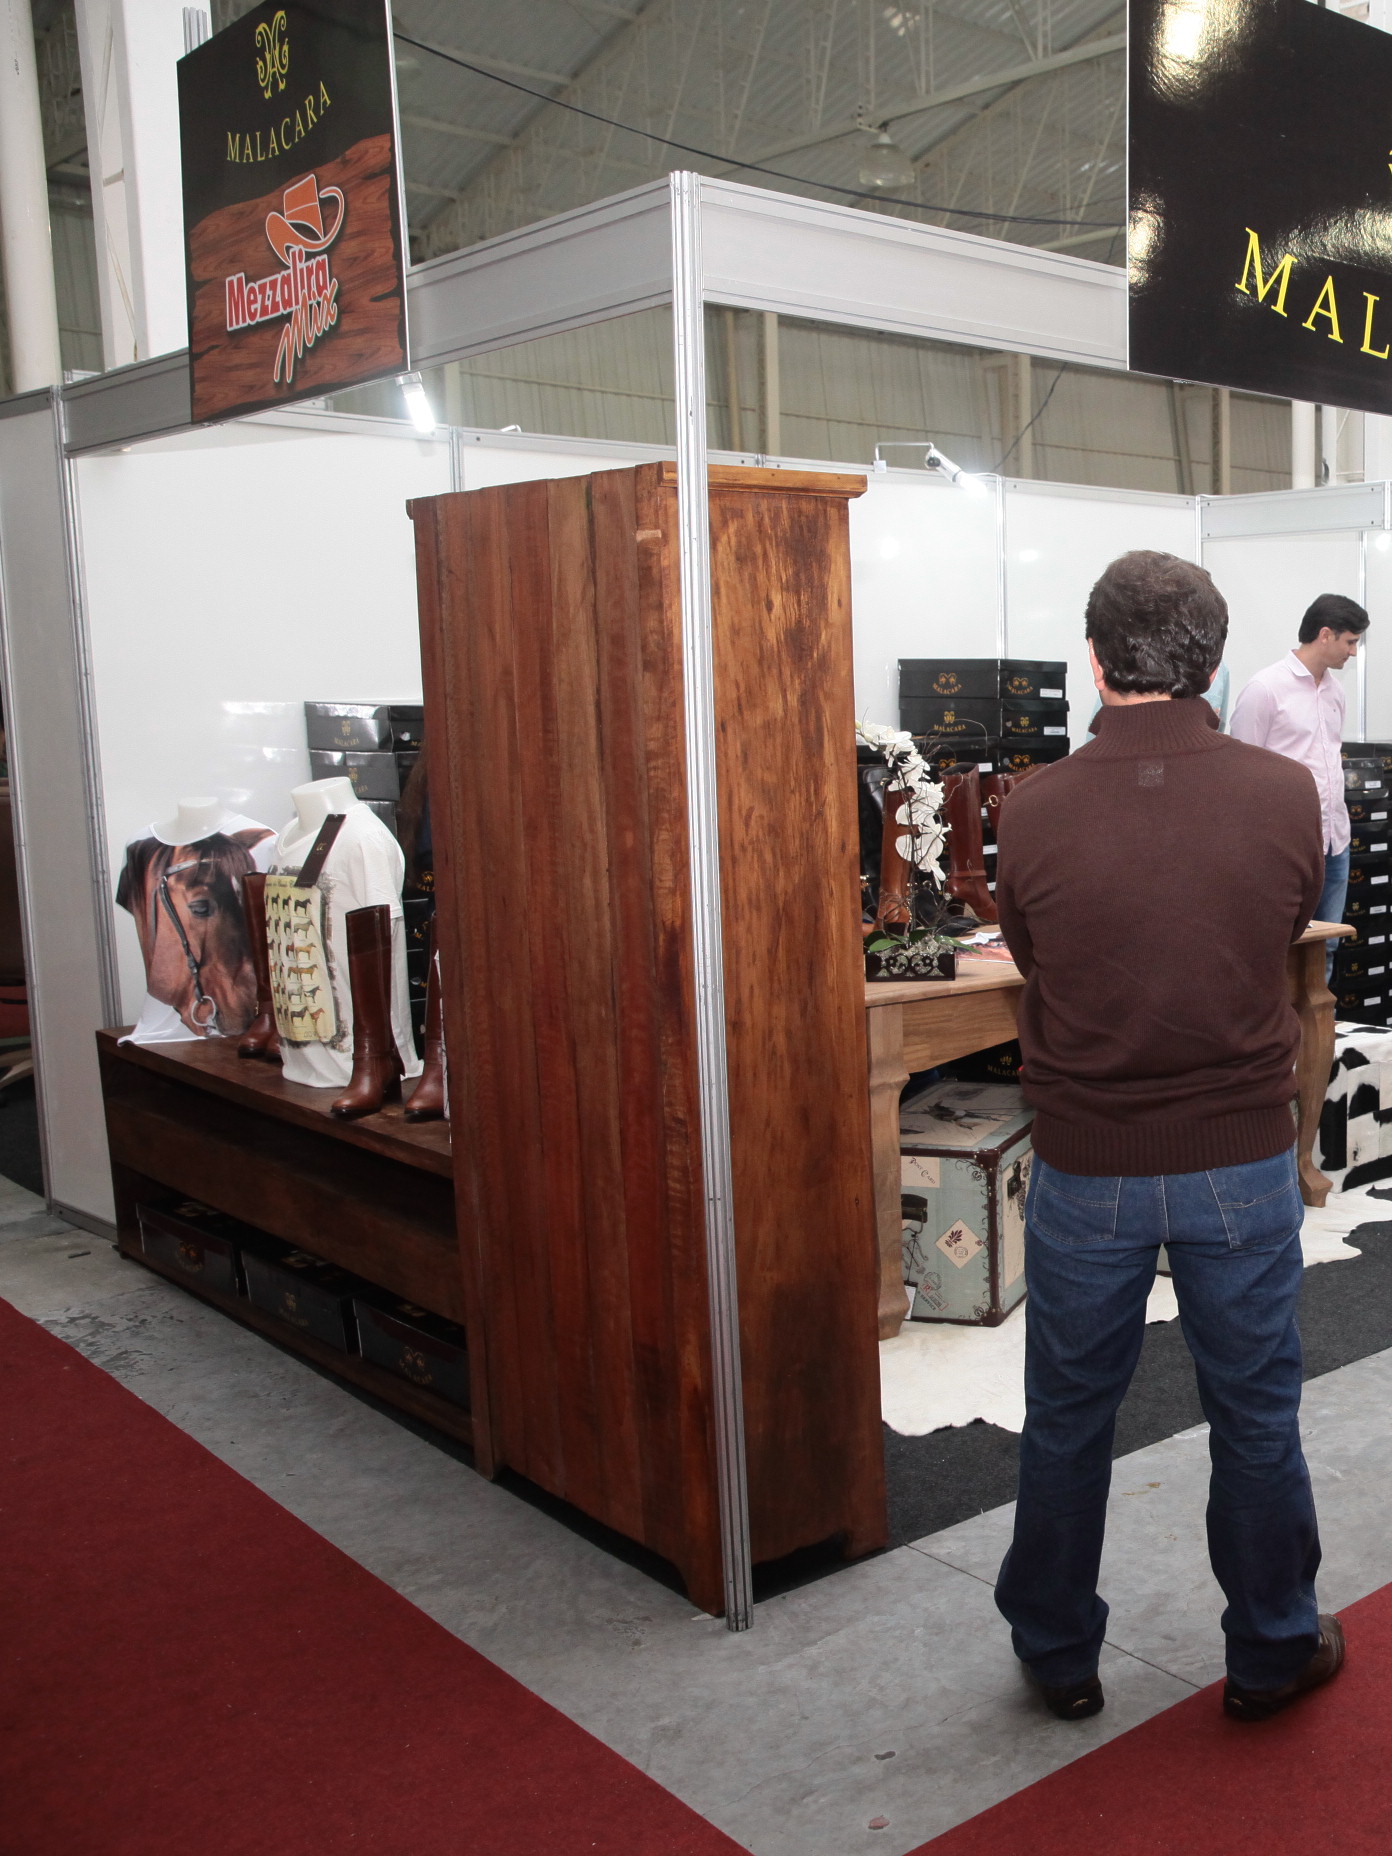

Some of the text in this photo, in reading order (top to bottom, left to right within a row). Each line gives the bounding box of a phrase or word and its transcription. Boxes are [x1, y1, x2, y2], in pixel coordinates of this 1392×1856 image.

[226, 80, 332, 163] MALACARA
[226, 246, 329, 331] Mezzalira
[273, 279, 338, 383] Mix
[932, 682, 963, 695] MALACARA
[1007, 685, 1034, 695] MALACARA
[933, 724, 967, 733] MALACARA
